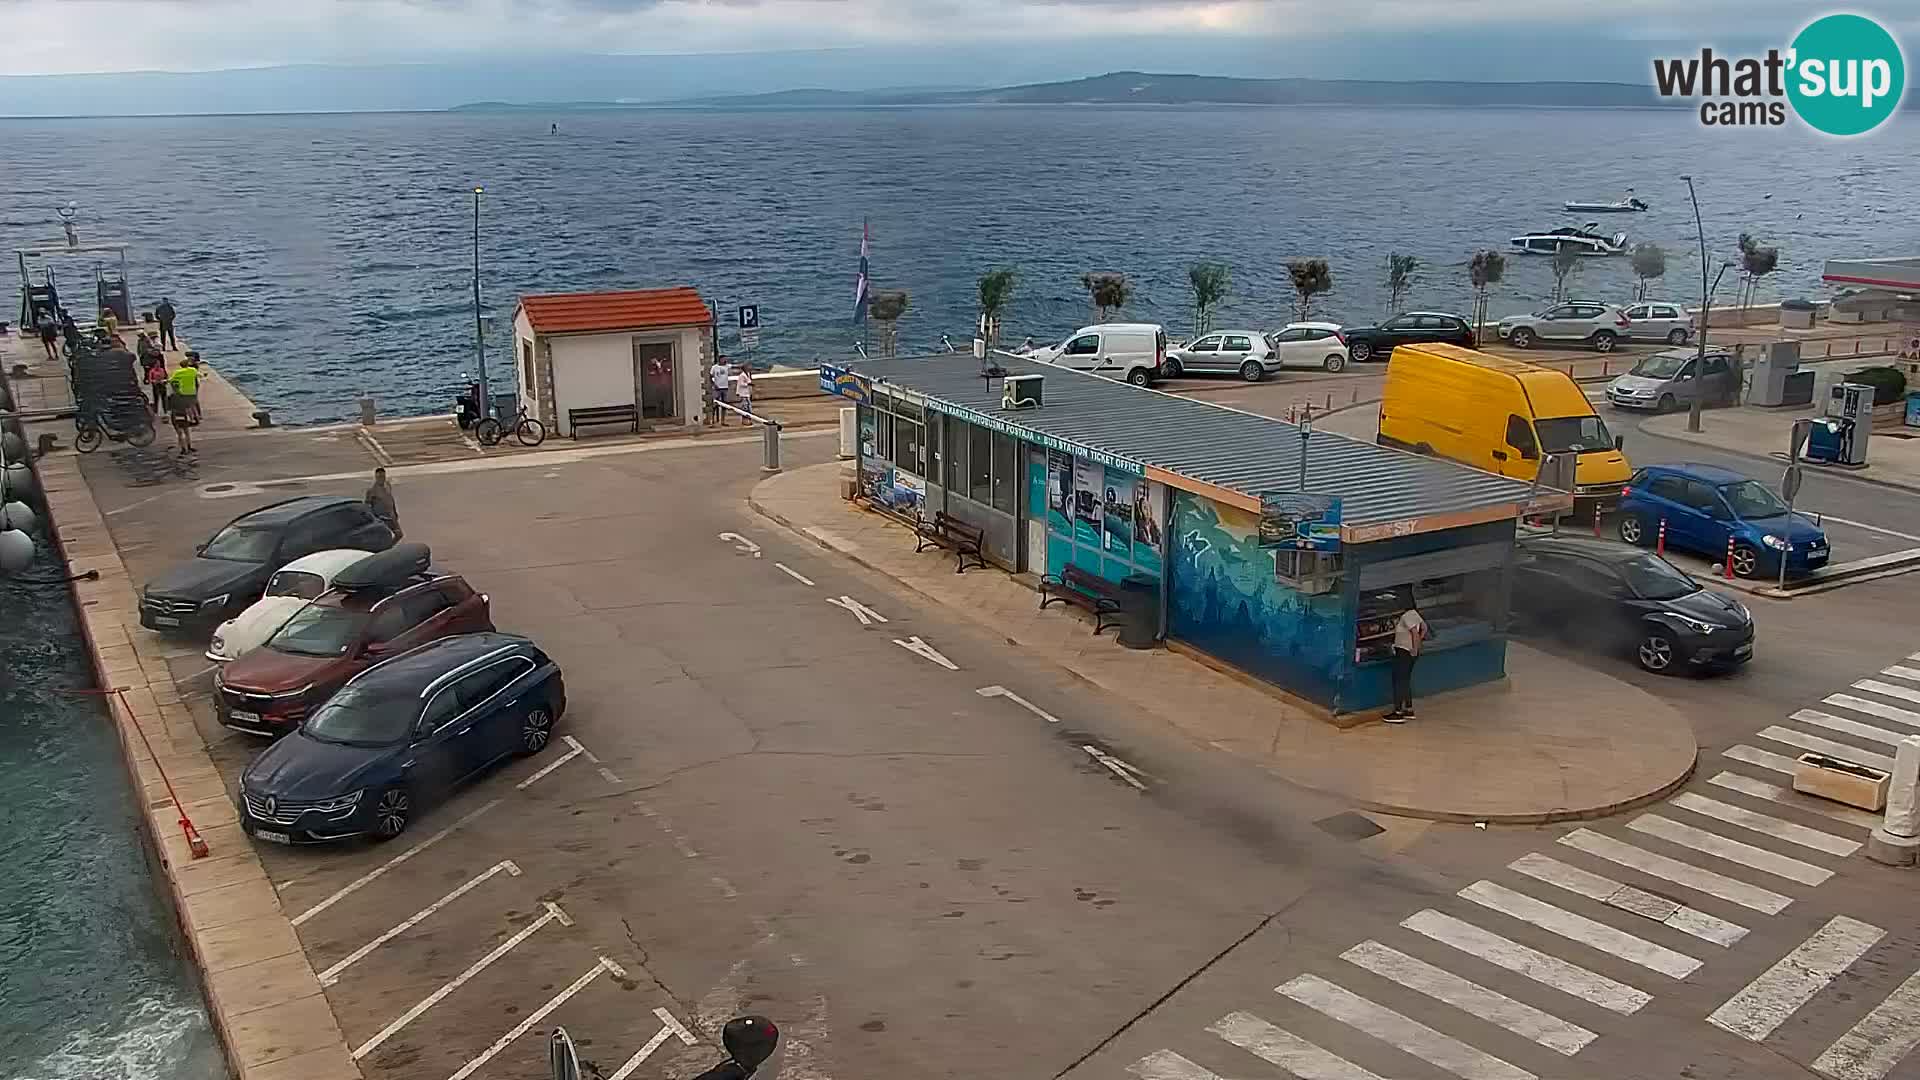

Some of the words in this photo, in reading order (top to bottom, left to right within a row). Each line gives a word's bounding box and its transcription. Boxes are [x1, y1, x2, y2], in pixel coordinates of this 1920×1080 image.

[743, 308, 754, 325] P
[969, 413, 1005, 432] AUTOBUSNA
[1005, 424, 1034, 441] POSTAJA
[1043, 436, 1058, 447] BUS
[1058, 441, 1088, 457] STATION
[1090, 450, 1115, 465] TICKET
[1115, 458, 1141, 474] OFFICE
